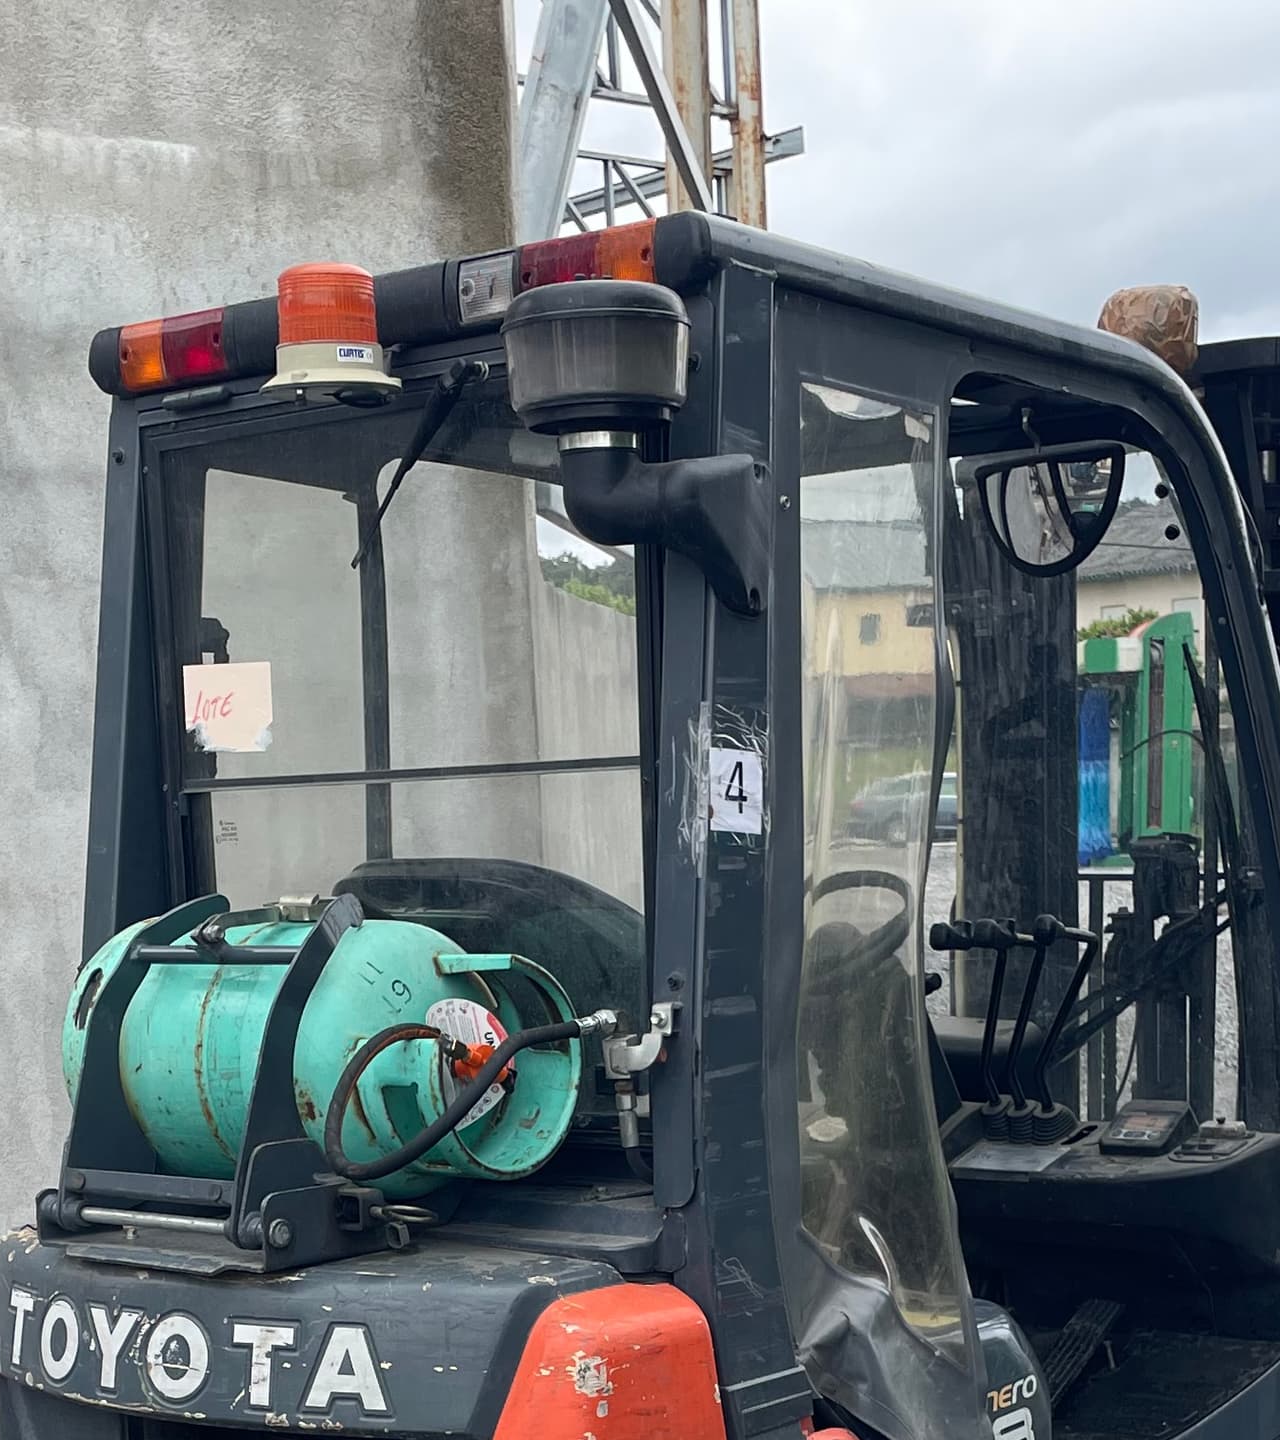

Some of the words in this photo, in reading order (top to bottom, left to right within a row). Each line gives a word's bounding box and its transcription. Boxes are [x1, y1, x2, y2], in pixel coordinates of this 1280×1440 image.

[339, 347, 365, 359] CURTIS
[192, 690, 234, 724] LOTE
[725, 761, 747, 814] 4
[9, 1287, 388, 1411] TOYOTA
